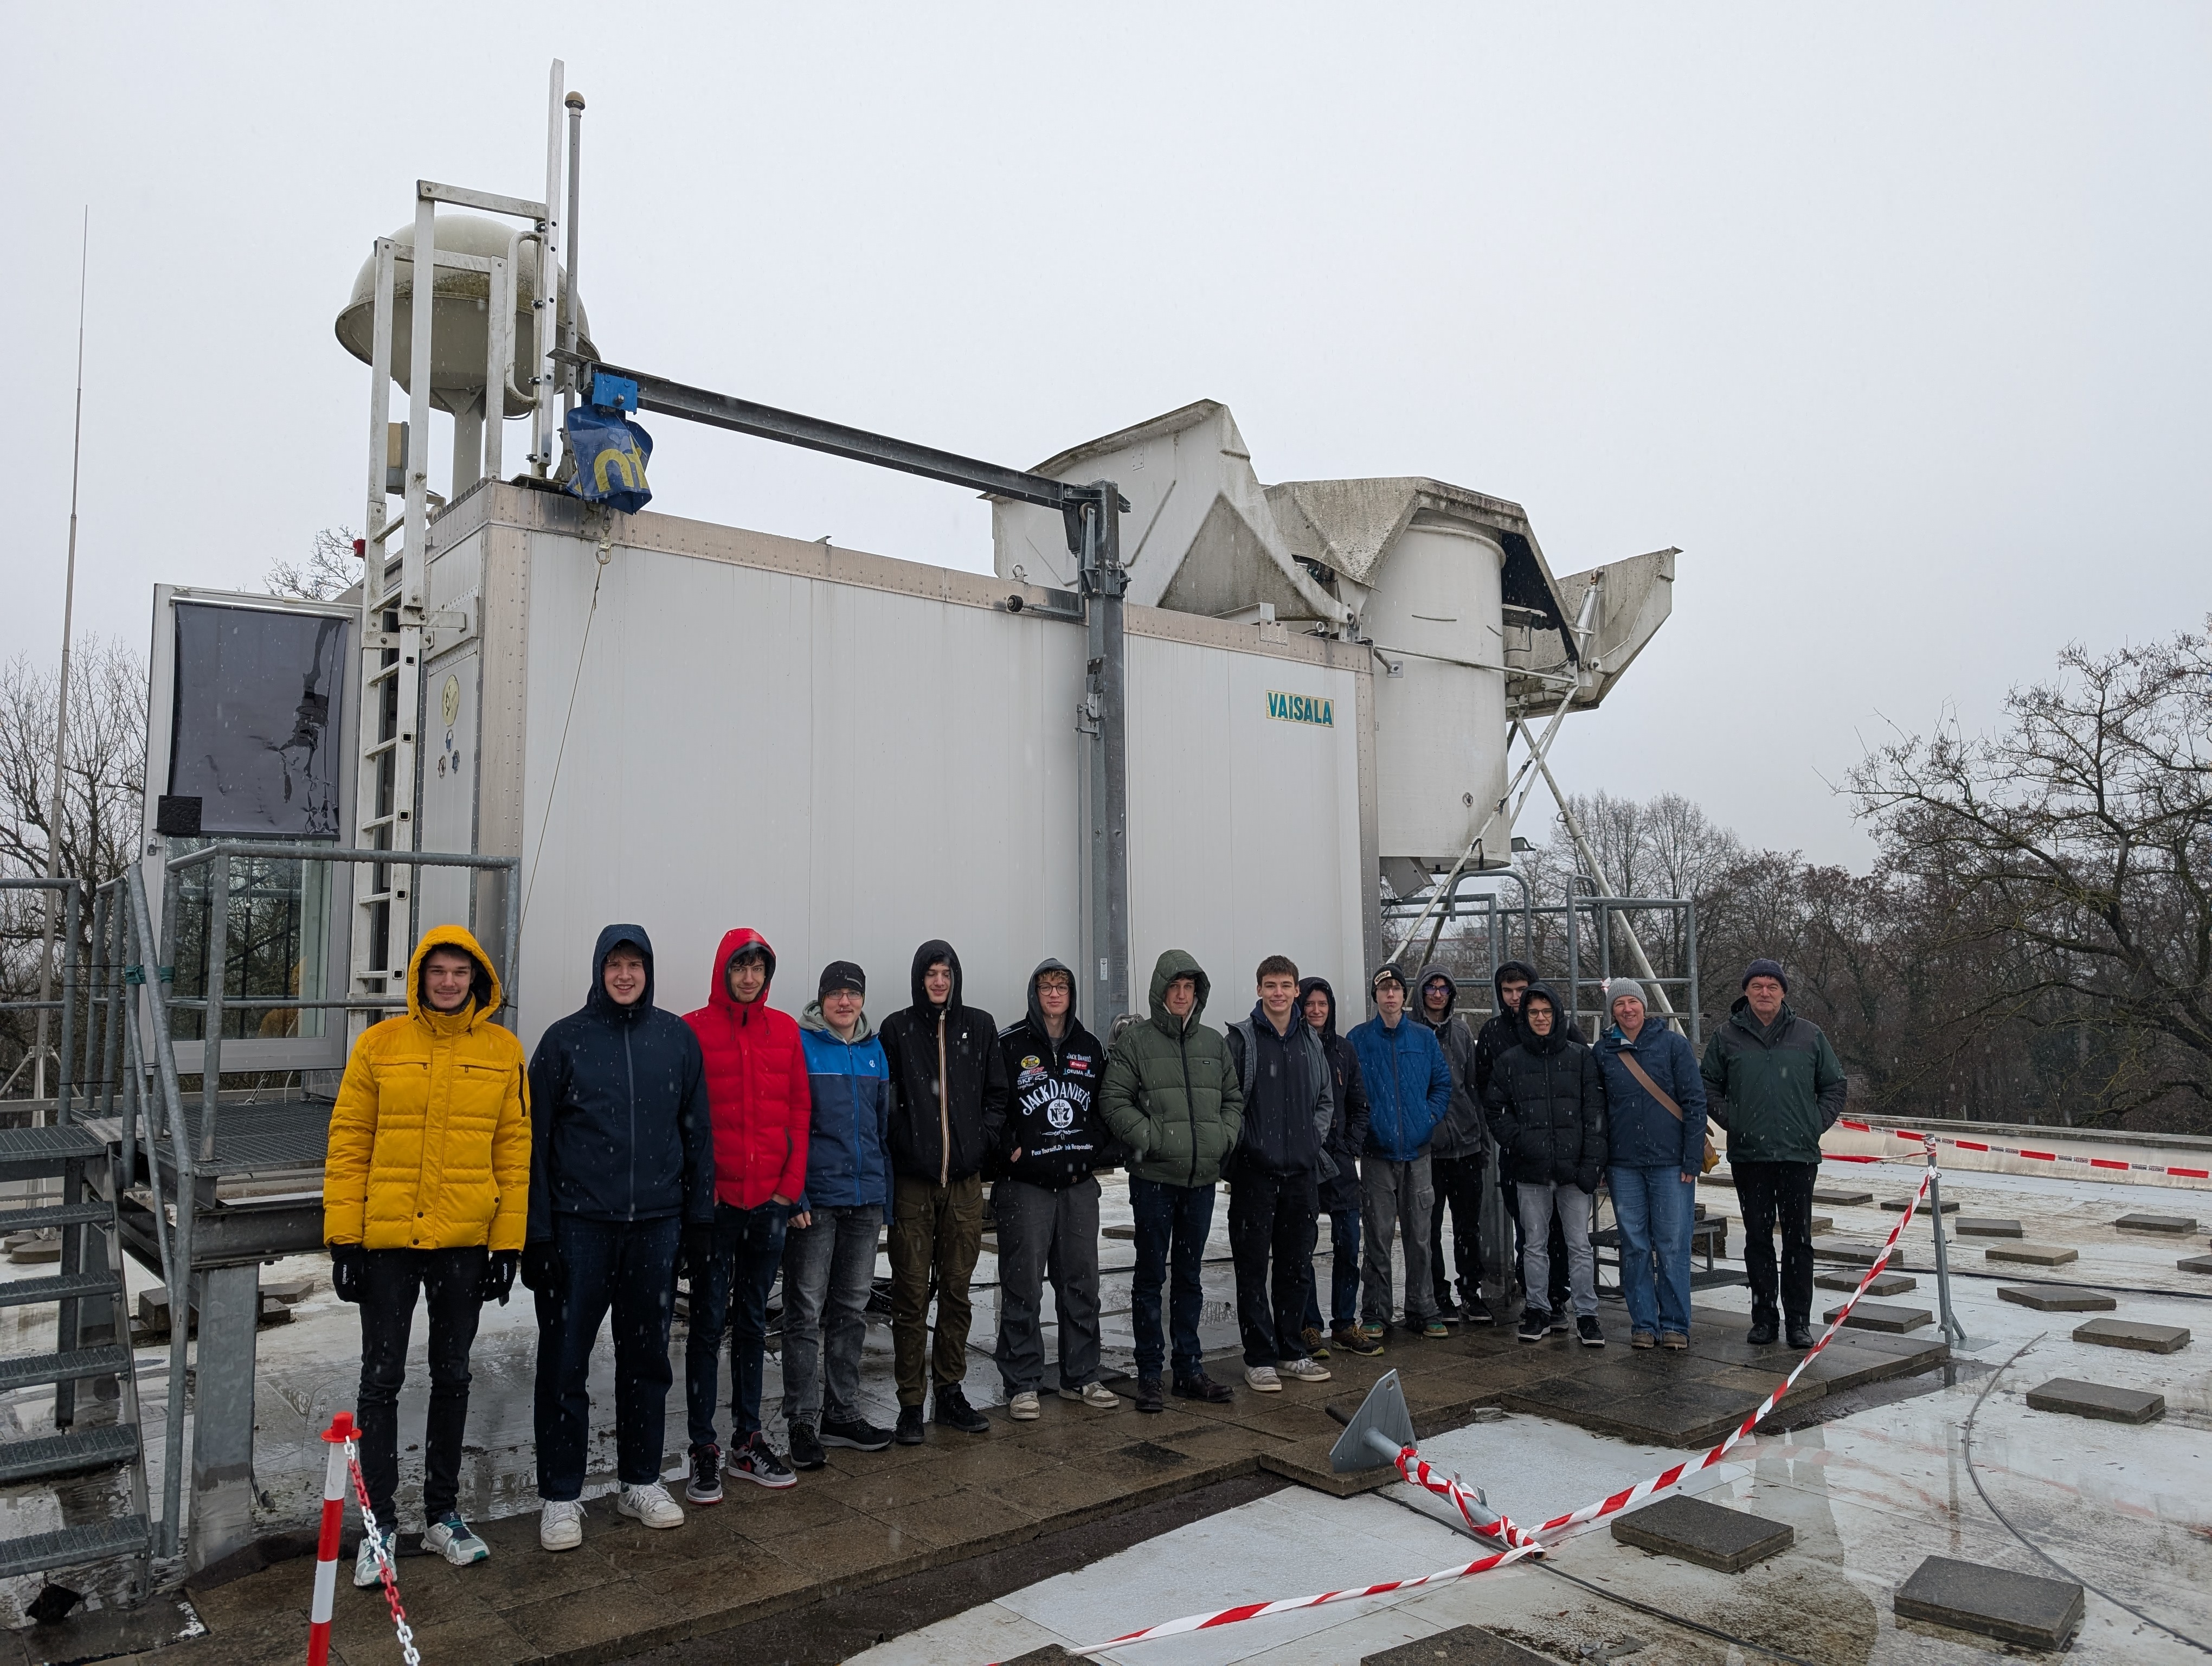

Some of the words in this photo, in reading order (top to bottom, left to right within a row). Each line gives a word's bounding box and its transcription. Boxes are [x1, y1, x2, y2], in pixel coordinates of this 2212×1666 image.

[1268, 692, 1333, 725] VAISALA
[1017, 1077, 1034, 1085] SKF
[1019, 1084, 1051, 1116] JACK
[1049, 1078, 1091, 1112] DANIEL'S
